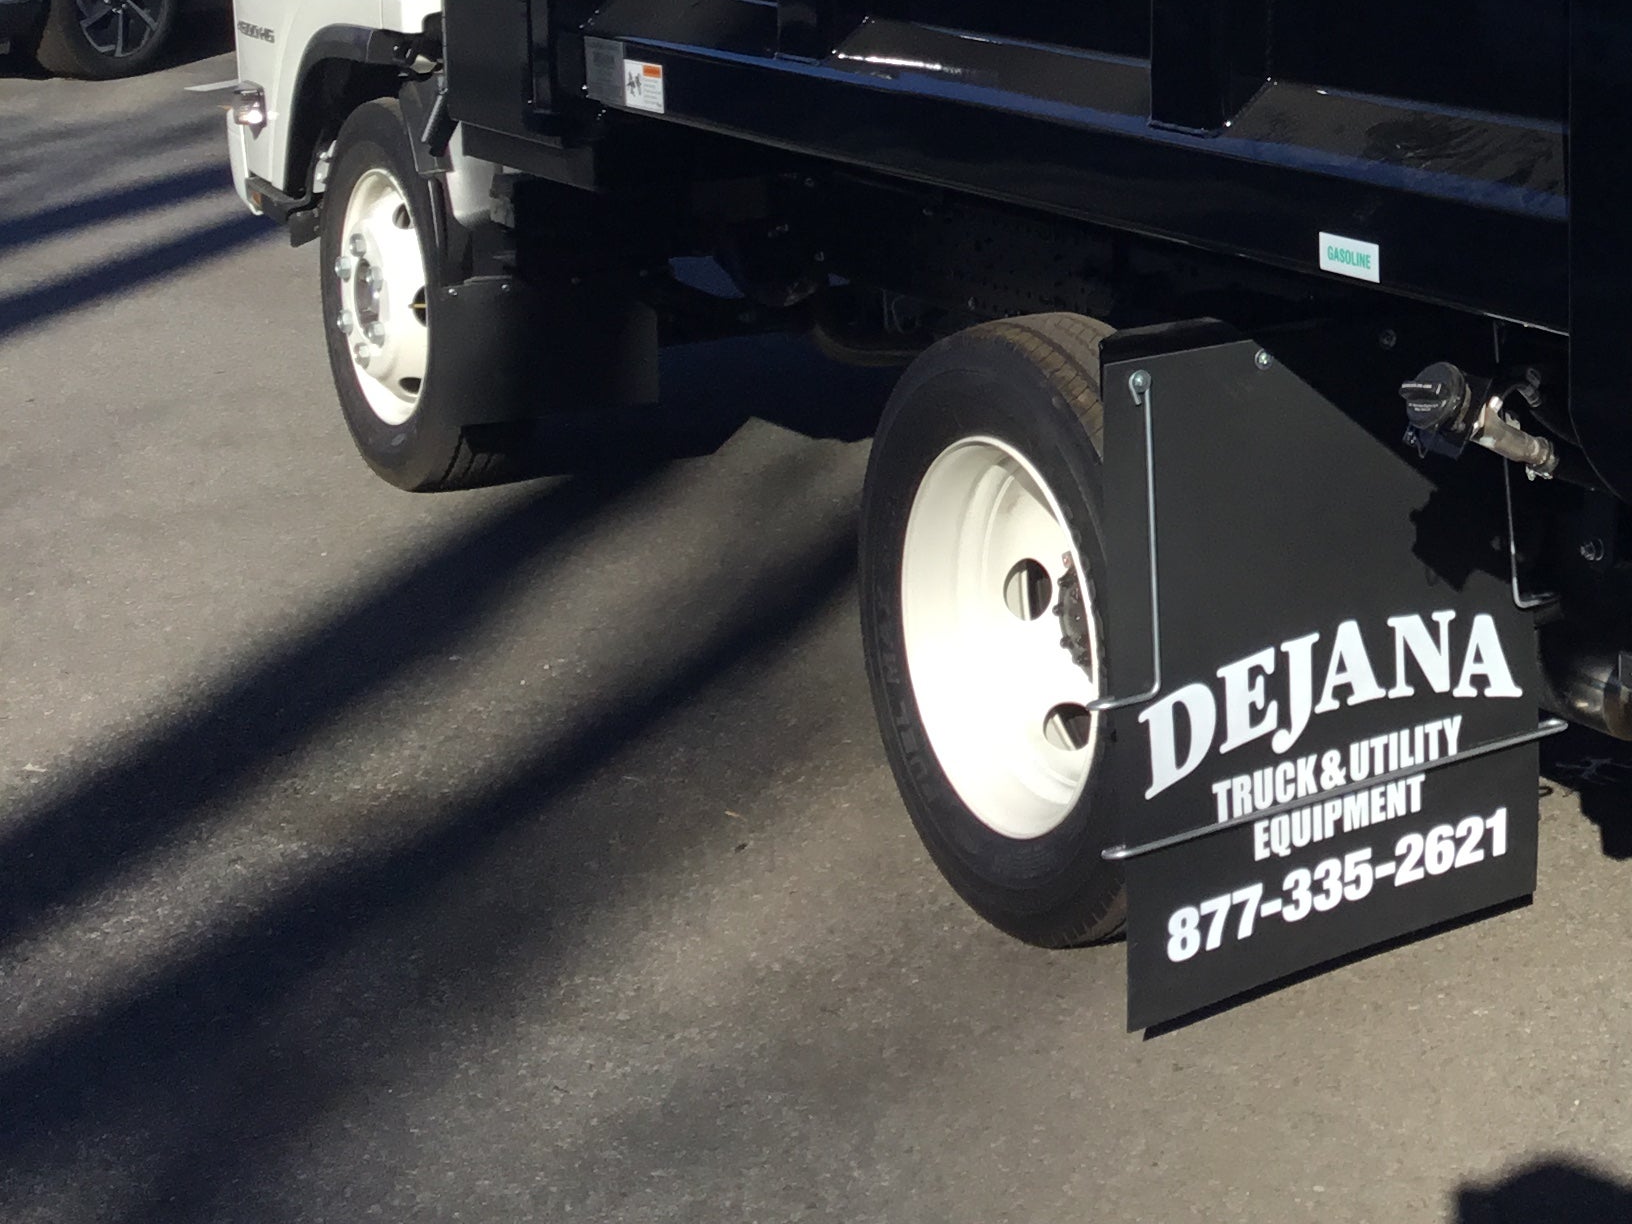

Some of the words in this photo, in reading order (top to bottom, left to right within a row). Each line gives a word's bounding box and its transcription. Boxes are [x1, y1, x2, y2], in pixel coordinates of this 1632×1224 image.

[1327, 245, 1371, 270] GASOLINE
[1138, 610, 1523, 800] DEJANA
[1212, 752, 1318, 824] TRUCK
[1349, 715, 1463, 778] UTILITY
[1253, 774, 1426, 862] EQUIPMENT
[1166, 807, 1508, 964] 877-335-2621
